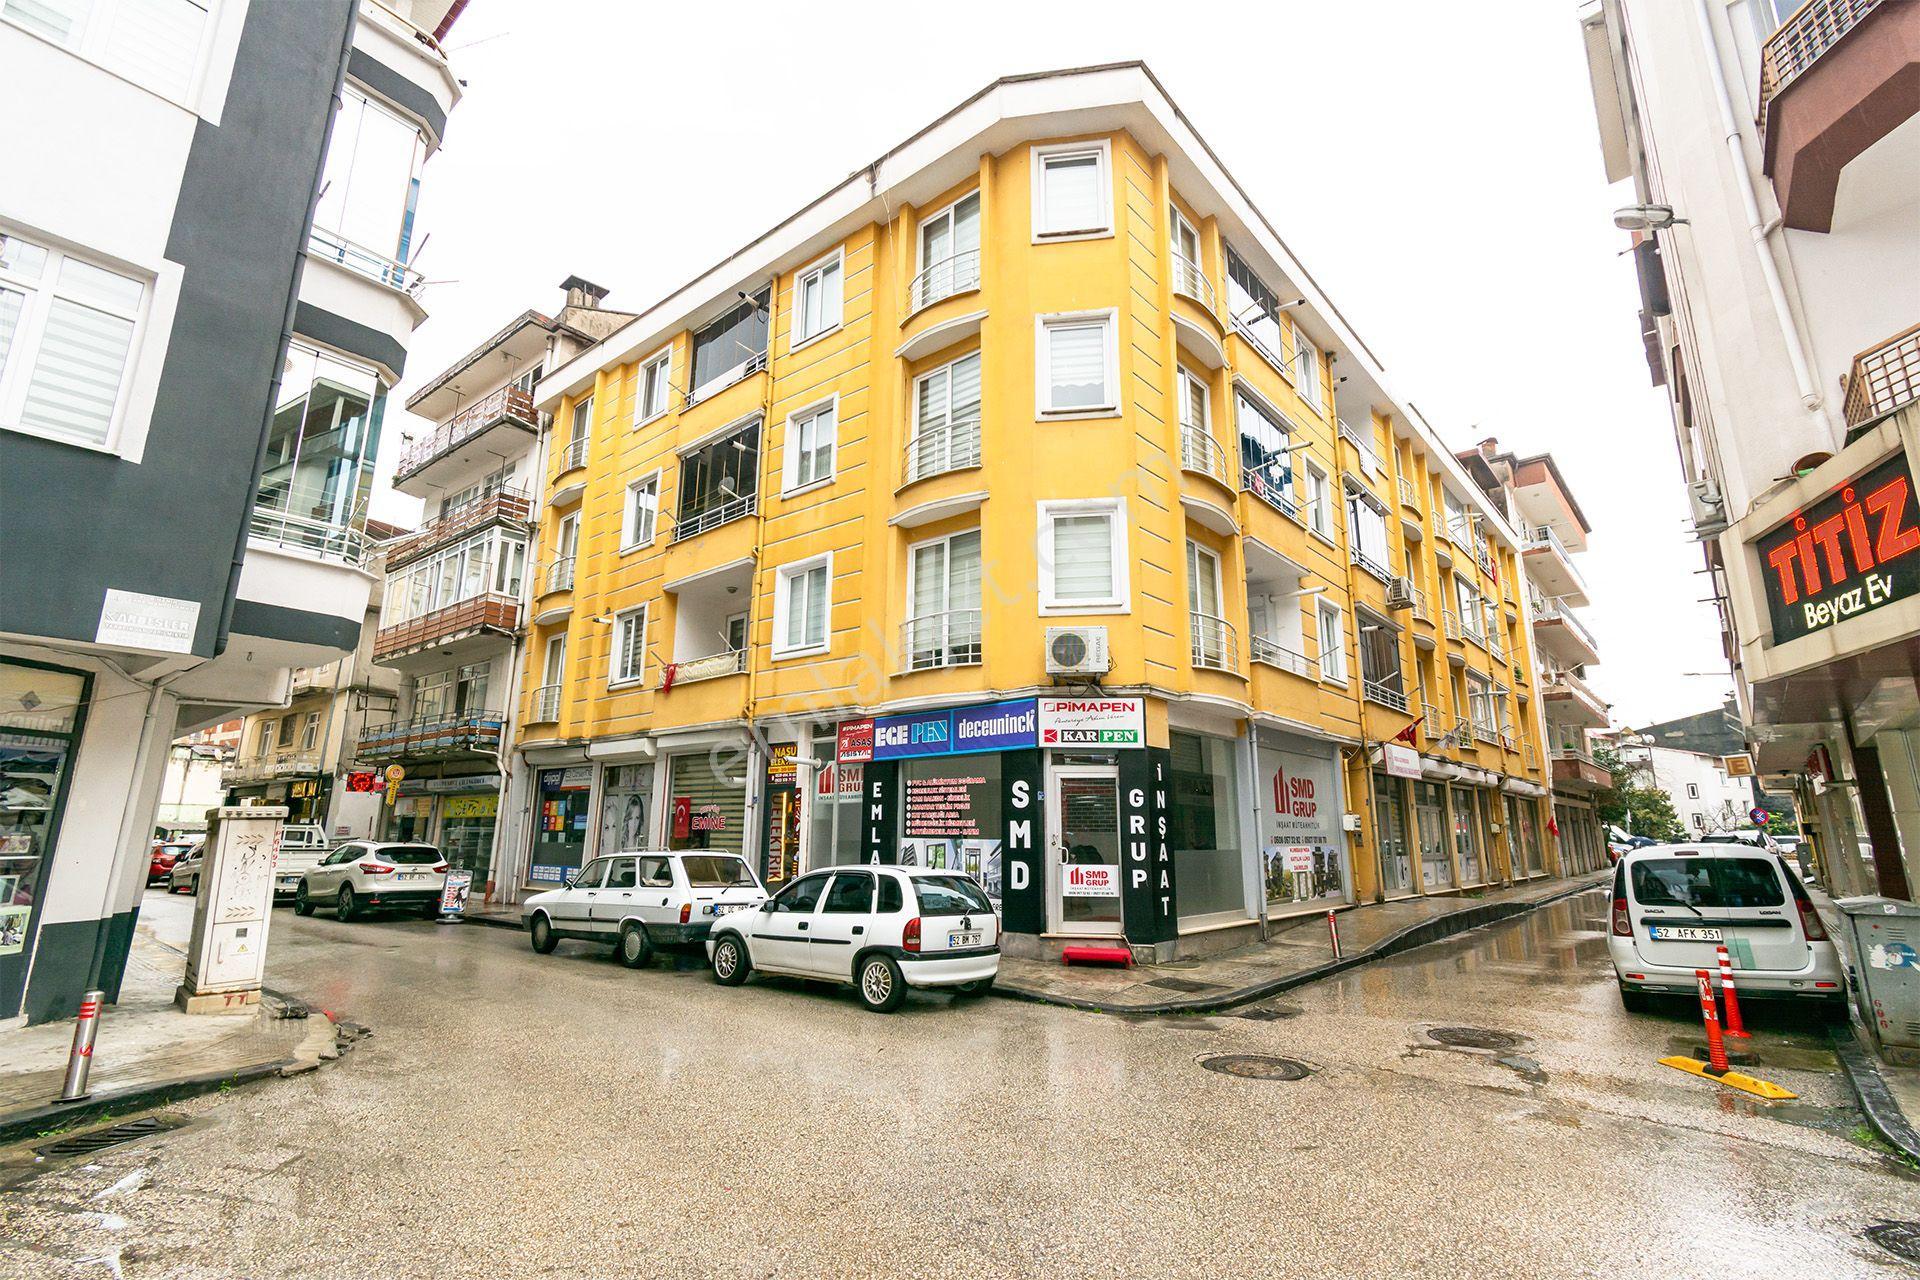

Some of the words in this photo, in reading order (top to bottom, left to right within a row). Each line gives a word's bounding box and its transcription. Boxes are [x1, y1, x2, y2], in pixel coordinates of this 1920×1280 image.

[1767, 476, 1920, 605] TİTİZ
[1803, 587, 1866, 629] Beyaz
[1865, 573, 1893, 605] Ev
[911, 719, 948, 745] PEN
[958, 712, 1035, 739] deceuninck
[1062, 730, 1098, 742] KAR
[1102, 730, 1135, 742] PEN
[1290, 777, 1315, 799] SMD
[1292, 801, 1317, 818] GRUP
[1009, 780, 1031, 890] SMD
[1129, 788, 1148, 889] GRUP
[1156, 763, 1170, 916] İNŞAAT
[1085, 870, 1108, 879] SMD
[953, 936, 960, 945] 52
[1656, 928, 1670, 938] 52
[1678, 929, 1697, 939] AFK
[1701, 930, 1720, 939] 351
